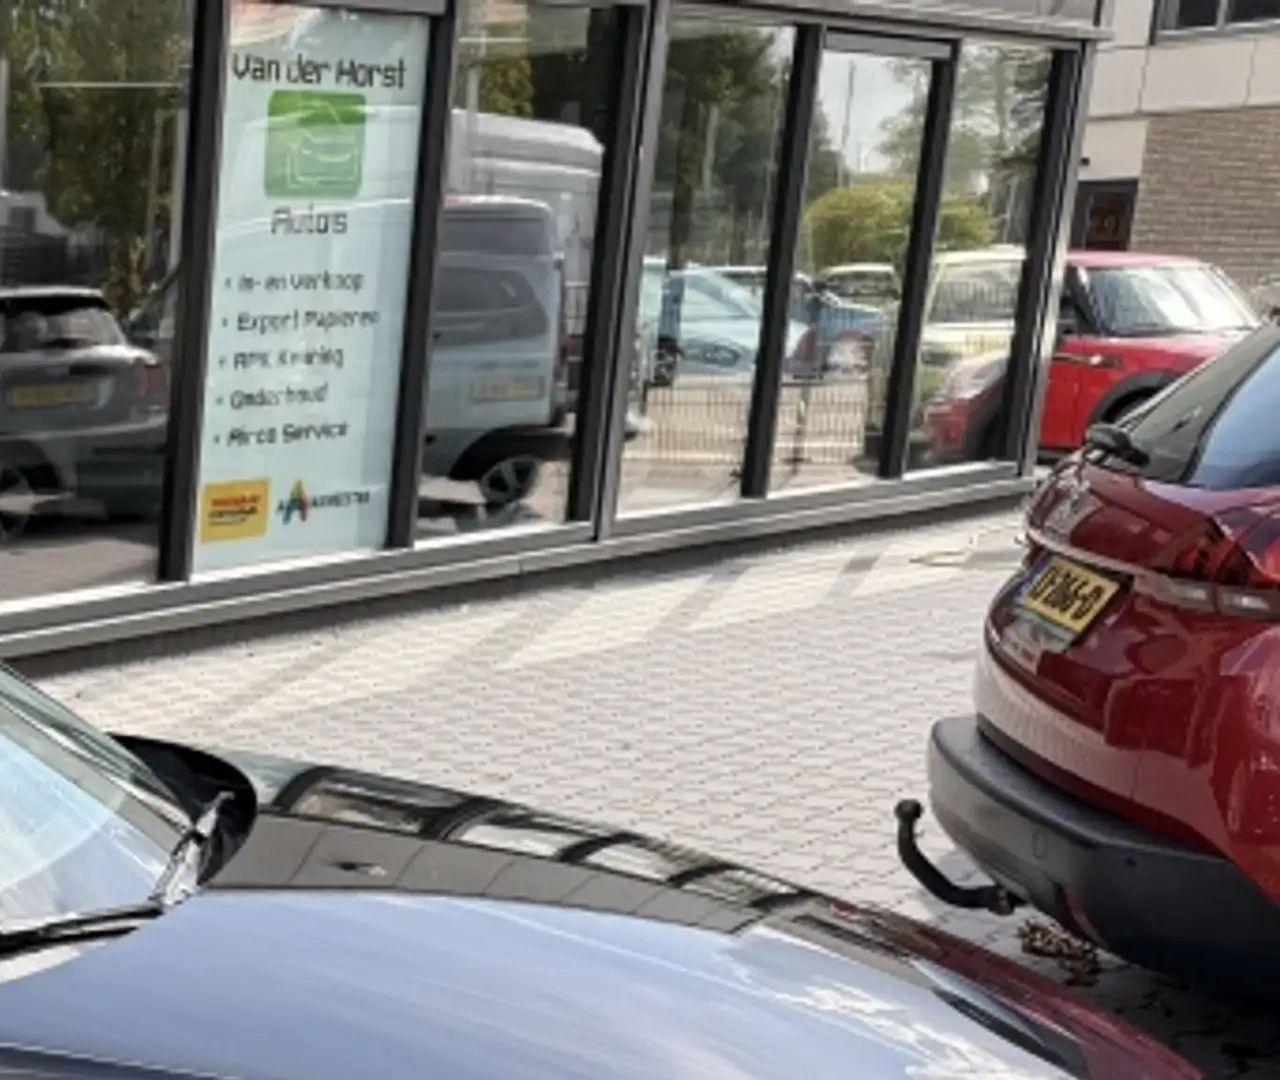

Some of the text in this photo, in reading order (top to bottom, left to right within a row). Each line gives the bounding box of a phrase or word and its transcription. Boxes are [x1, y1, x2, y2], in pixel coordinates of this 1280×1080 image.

[232, 53, 407, 89] Van der Horst
